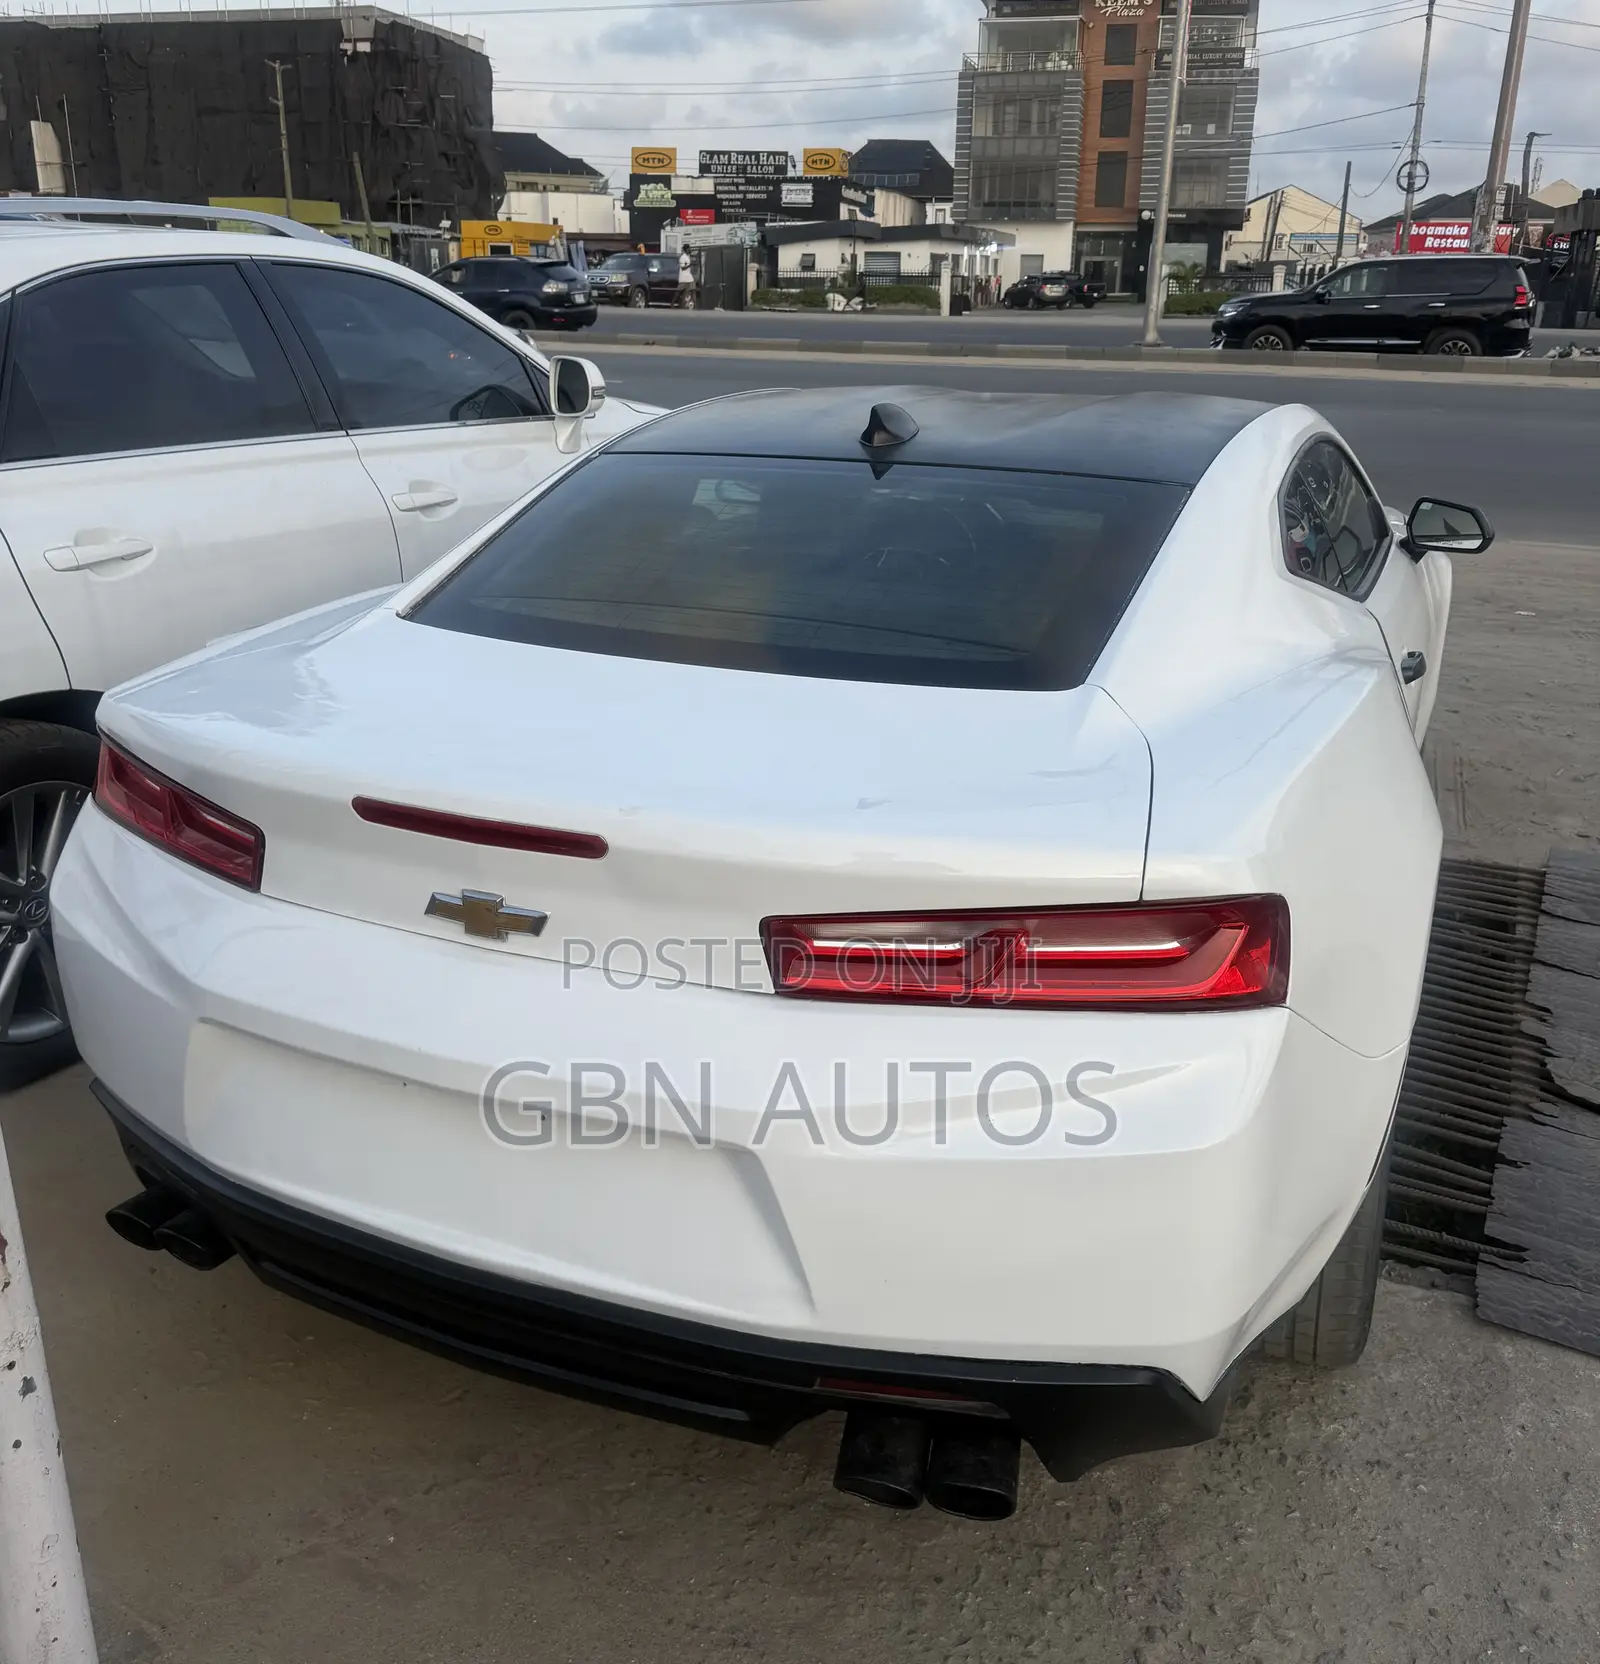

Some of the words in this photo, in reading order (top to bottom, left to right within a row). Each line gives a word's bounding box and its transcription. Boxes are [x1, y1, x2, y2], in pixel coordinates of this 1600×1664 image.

[1100, 4, 1145, 17] Plaza
[700, 152, 728, 164] GLAM
[730, 152, 758, 165] REAL
[759, 152, 786, 165] HAIR
[711, 165, 743, 173] UNISE
[747, 165, 774, 174] SALON
[1399, 224, 1469, 235] Iboamaka
[1424, 236, 1470, 248] Restau
